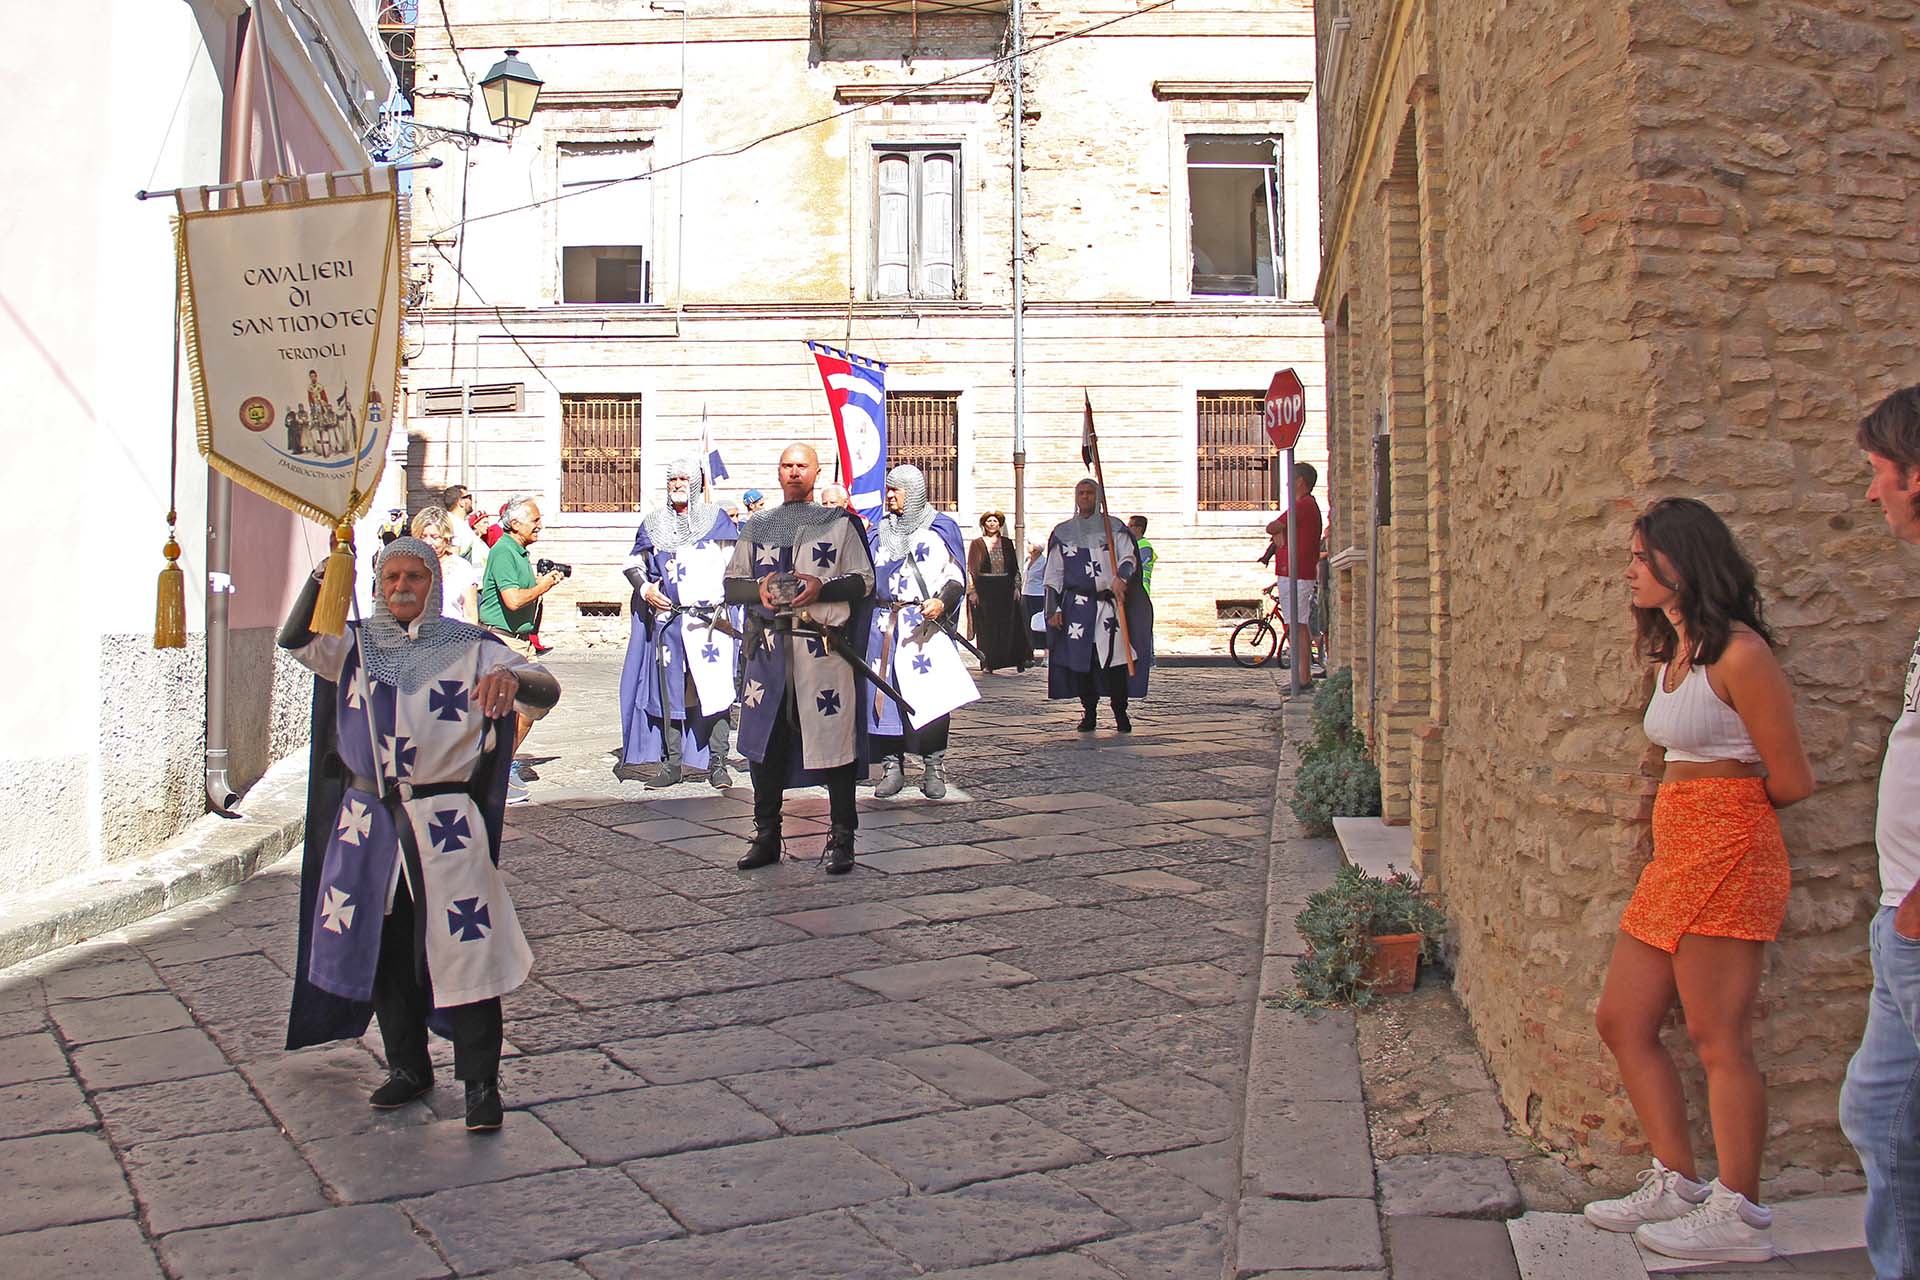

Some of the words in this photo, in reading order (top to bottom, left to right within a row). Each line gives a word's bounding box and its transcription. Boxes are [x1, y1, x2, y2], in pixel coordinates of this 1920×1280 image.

[244, 260, 353, 286] CAVALIERI
[289, 286, 311, 307] DI
[232, 316, 274, 337] SAN
[277, 308, 377, 334] TIMOTEO
[278, 343, 346, 360] TERMOLI
[1266, 393, 1301, 428] STOP
